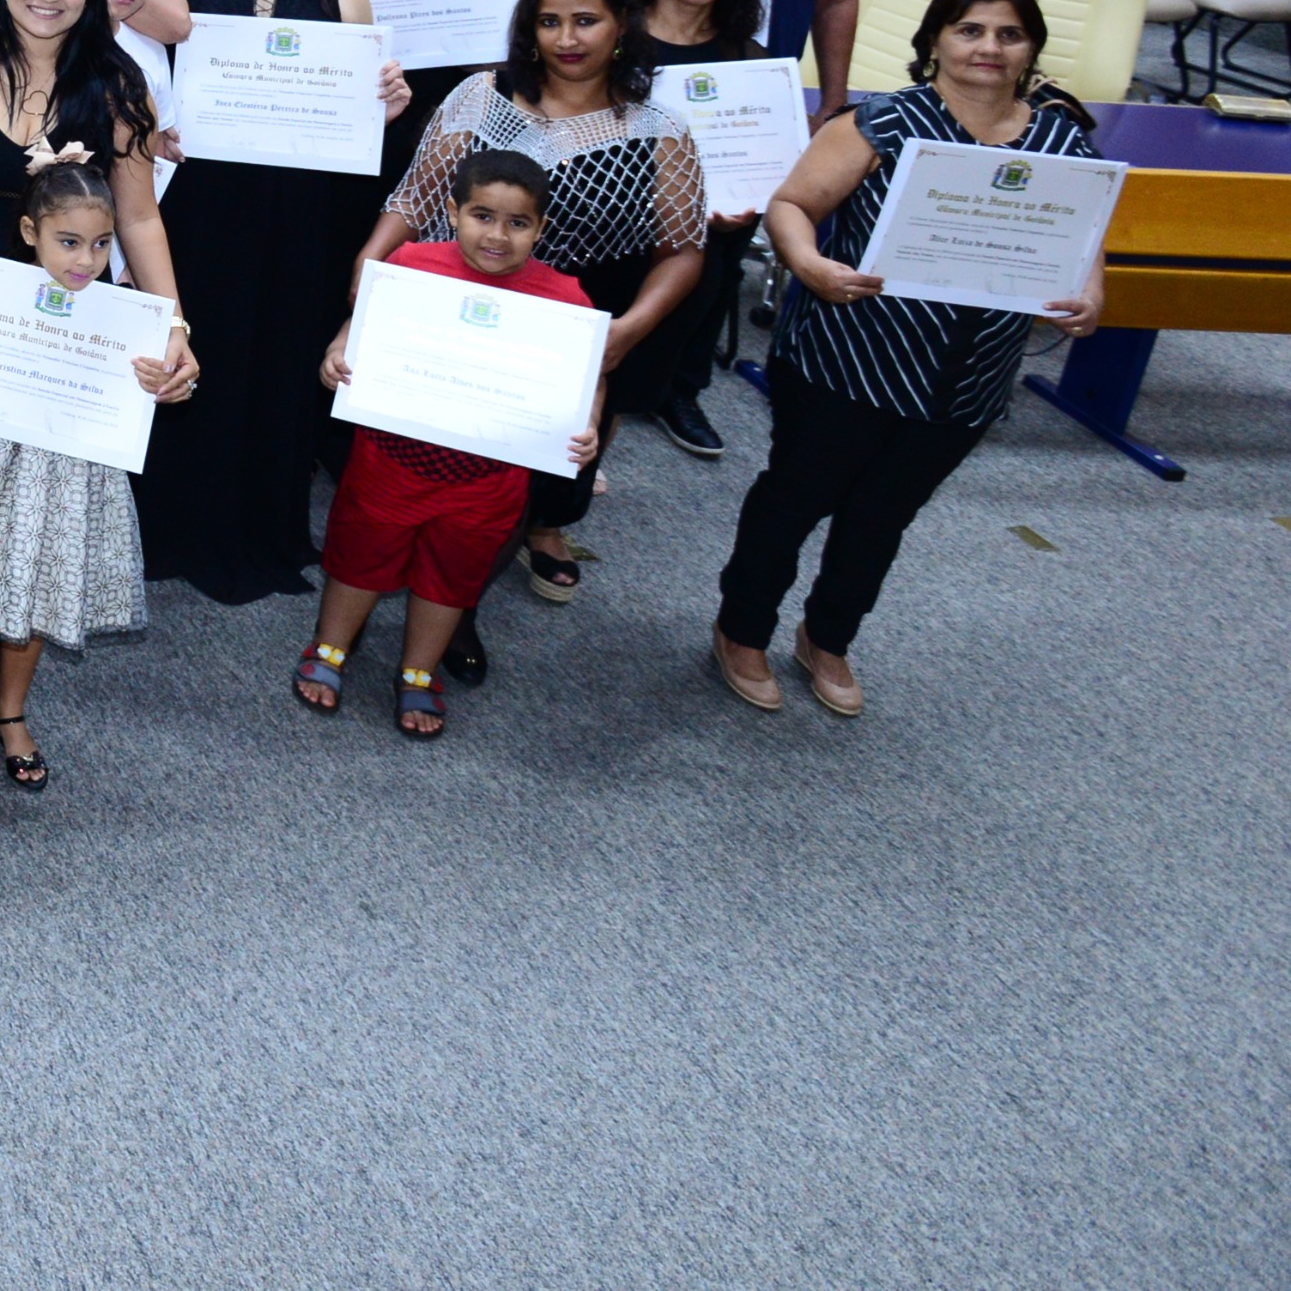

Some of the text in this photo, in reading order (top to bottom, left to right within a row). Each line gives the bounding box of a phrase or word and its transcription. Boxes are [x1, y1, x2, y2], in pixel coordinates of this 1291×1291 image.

[209, 56, 249, 69] Diploma
[253, 61, 264, 70] de
[268, 61, 299, 73] Honra
[318, 66, 353, 77] Mérito
[926, 188, 1075, 215] Diploma de Honra ao Mérito
[18, 315, 30, 328] de
[34, 318, 69, 338] Honra
[72, 331, 85, 341] ao
[88, 333, 126, 351] Mérito
[18, 332, 60, 350] Municipal
[62, 342, 73, 352] de
[74, 346, 107, 361] Goiânia
[27, 369, 66, 386] Marques
[67, 379, 78, 388] da
[79, 382, 103, 395] Silva
